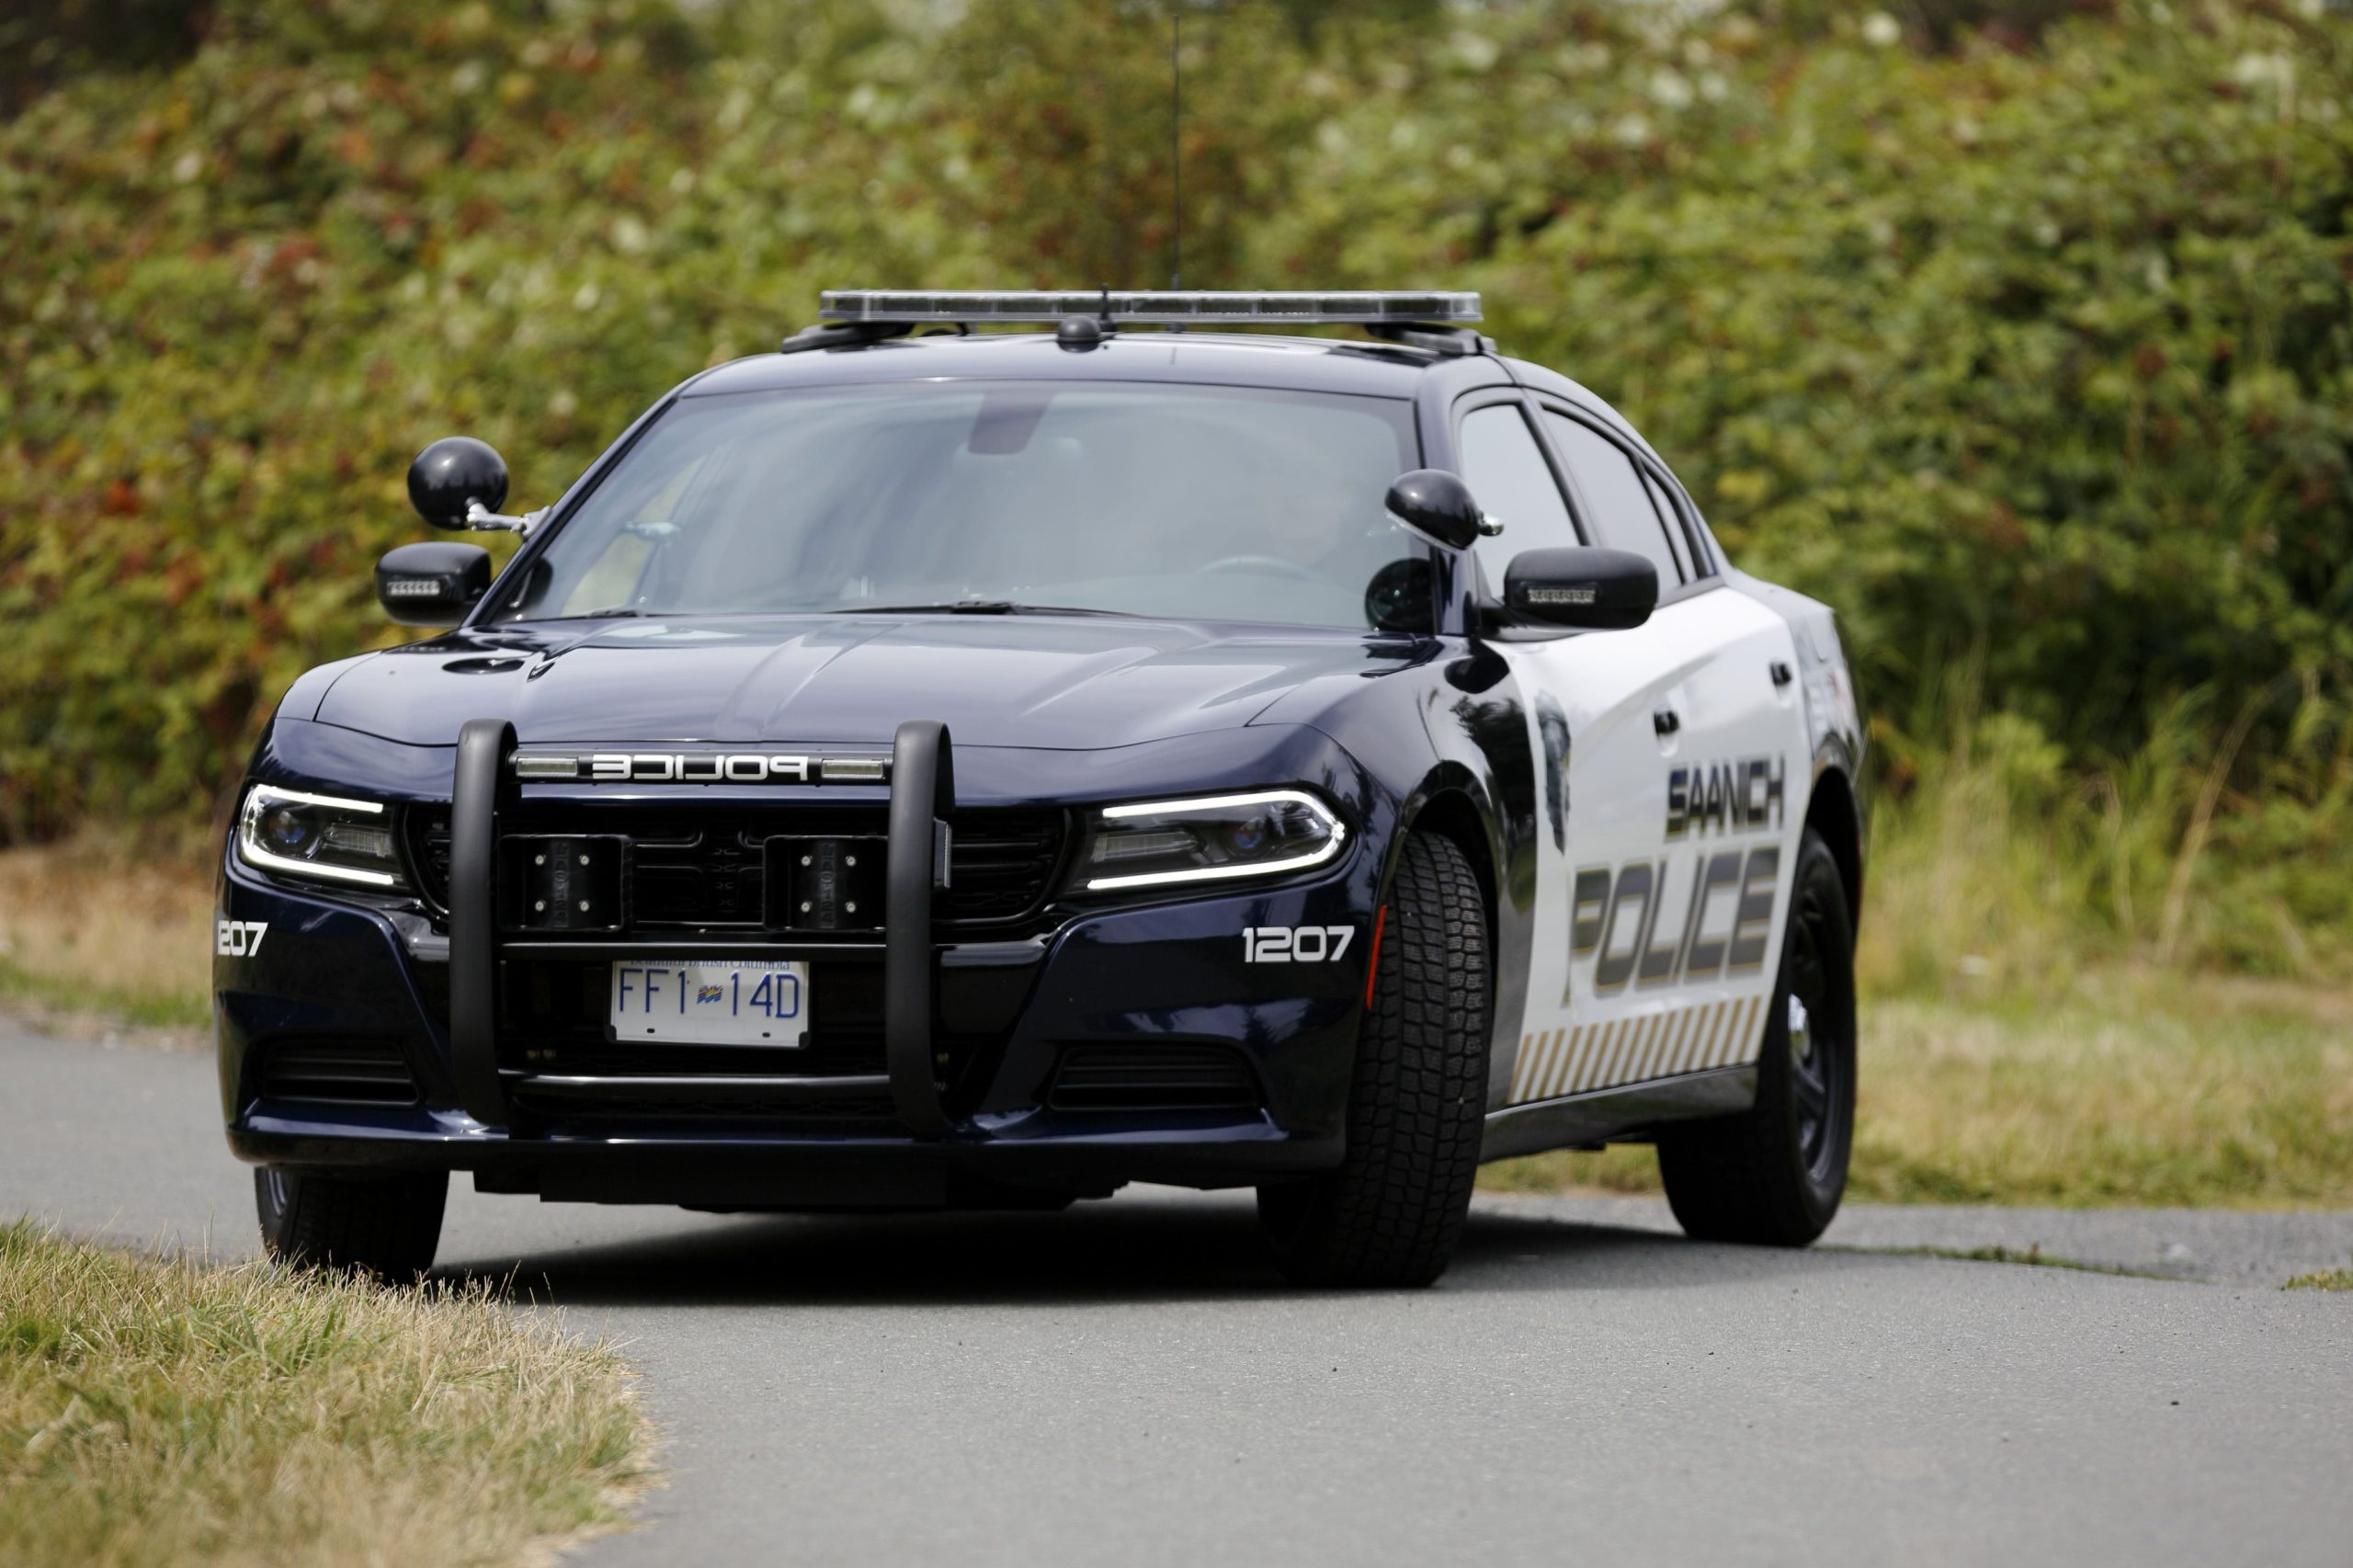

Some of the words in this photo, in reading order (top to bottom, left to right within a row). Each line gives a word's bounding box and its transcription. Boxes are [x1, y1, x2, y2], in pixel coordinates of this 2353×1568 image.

[1665, 754, 1786, 841] SAANICH
[1242, 925, 1355, 963] 1207
[1562, 845, 1780, 1007] POLICE
[619, 968, 687, 1015] FF1
[731, 971, 800, 1019] 14D
